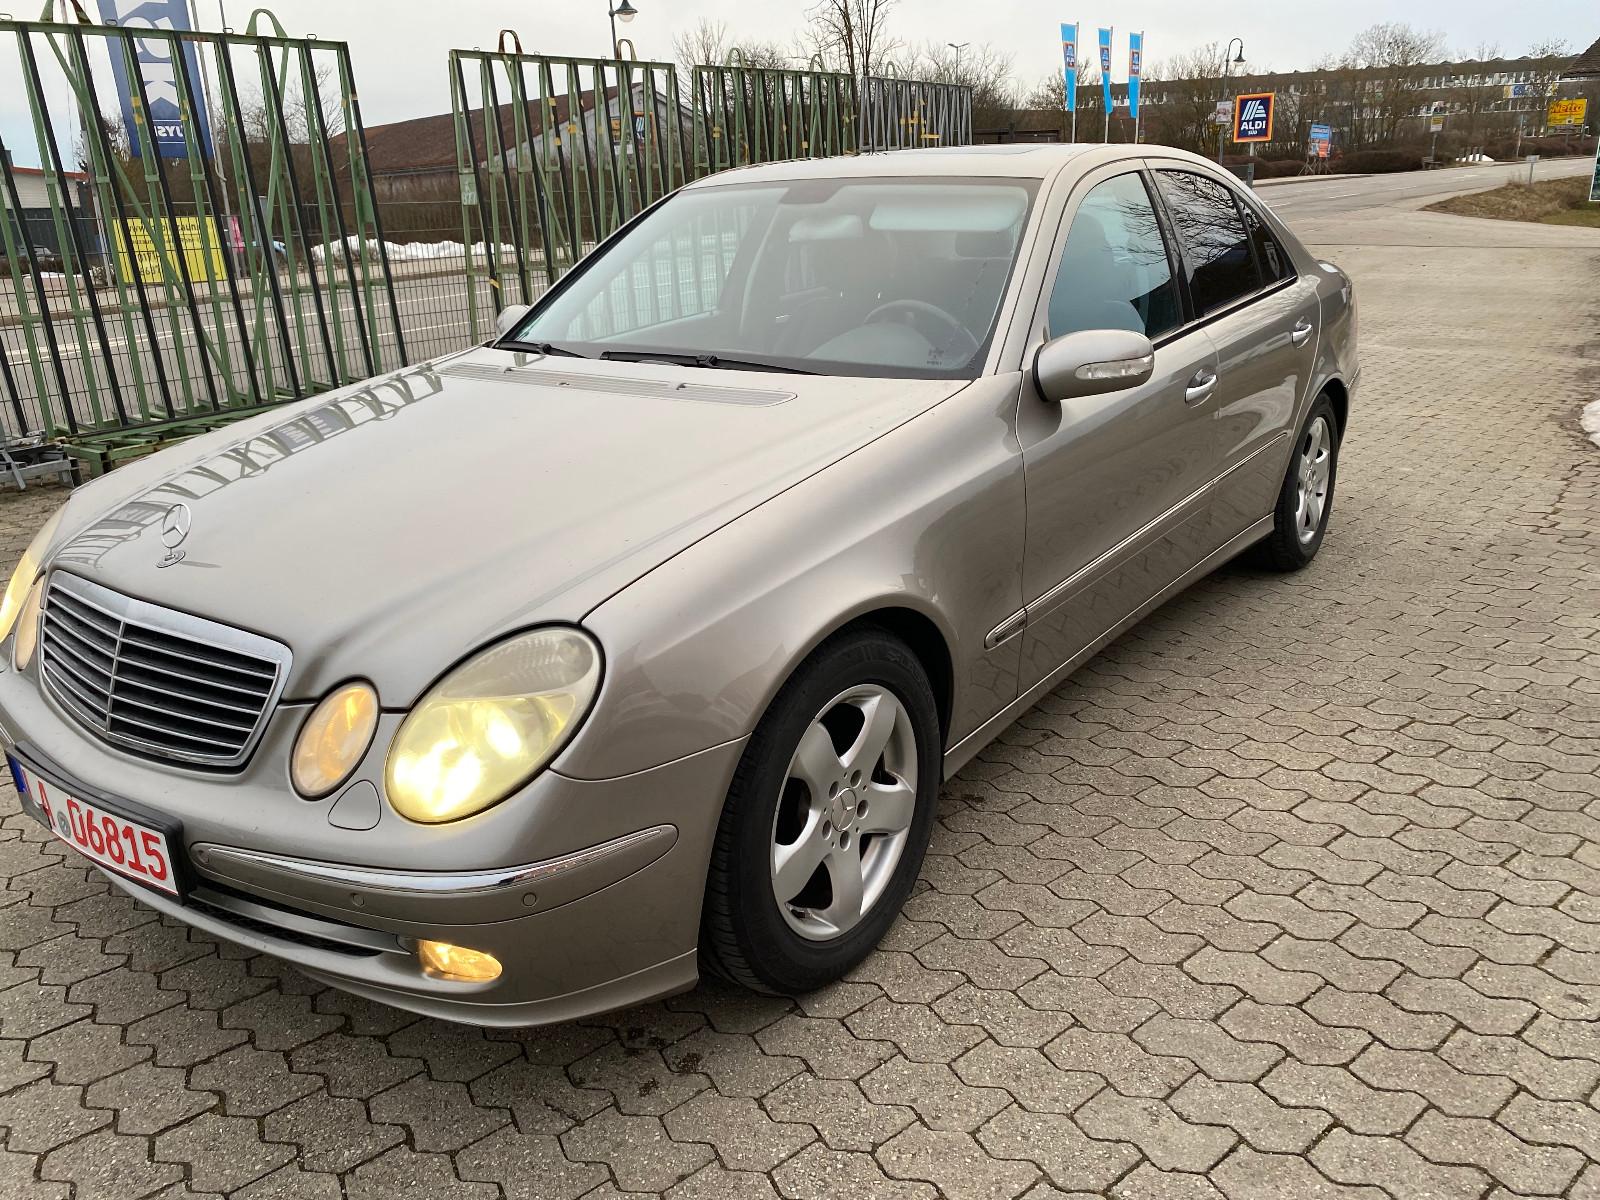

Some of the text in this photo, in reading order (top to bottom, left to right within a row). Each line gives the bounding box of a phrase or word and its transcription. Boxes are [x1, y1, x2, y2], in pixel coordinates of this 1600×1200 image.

[1551, 101, 1583, 113] Netto
[1240, 120, 1266, 130] ALDI
[66, 798, 167, 881] 06815
